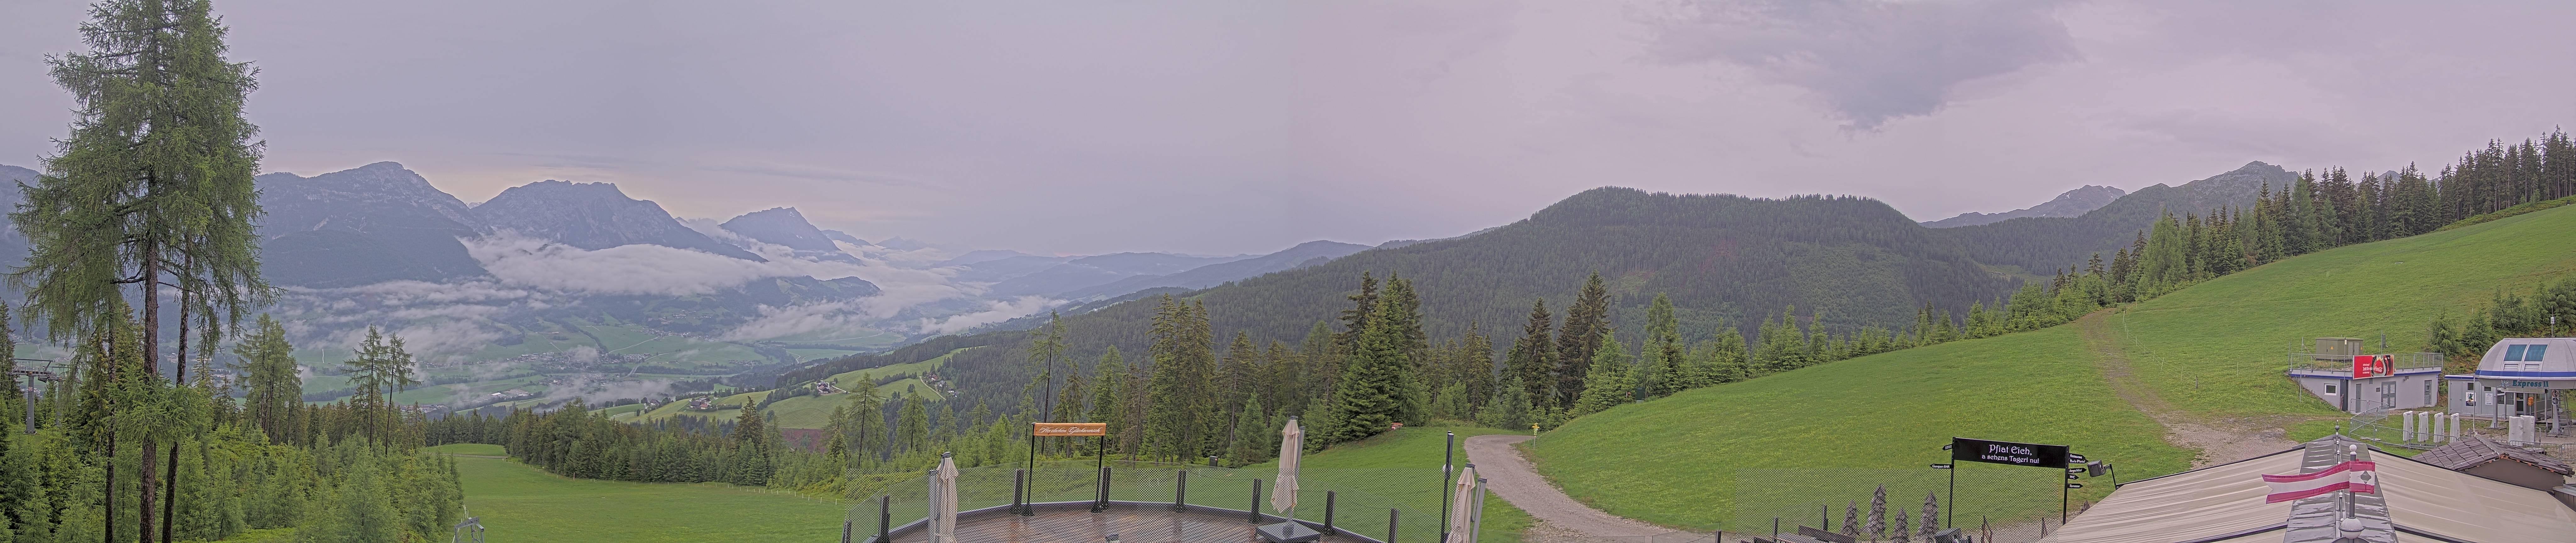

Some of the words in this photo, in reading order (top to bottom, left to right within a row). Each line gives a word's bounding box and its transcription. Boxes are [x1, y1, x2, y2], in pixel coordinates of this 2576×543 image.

[2512, 380, 2542, 388] Express
[1989, 444, 2009, 454] Pfiat
[2011, 446, 2032, 456] Eich,
